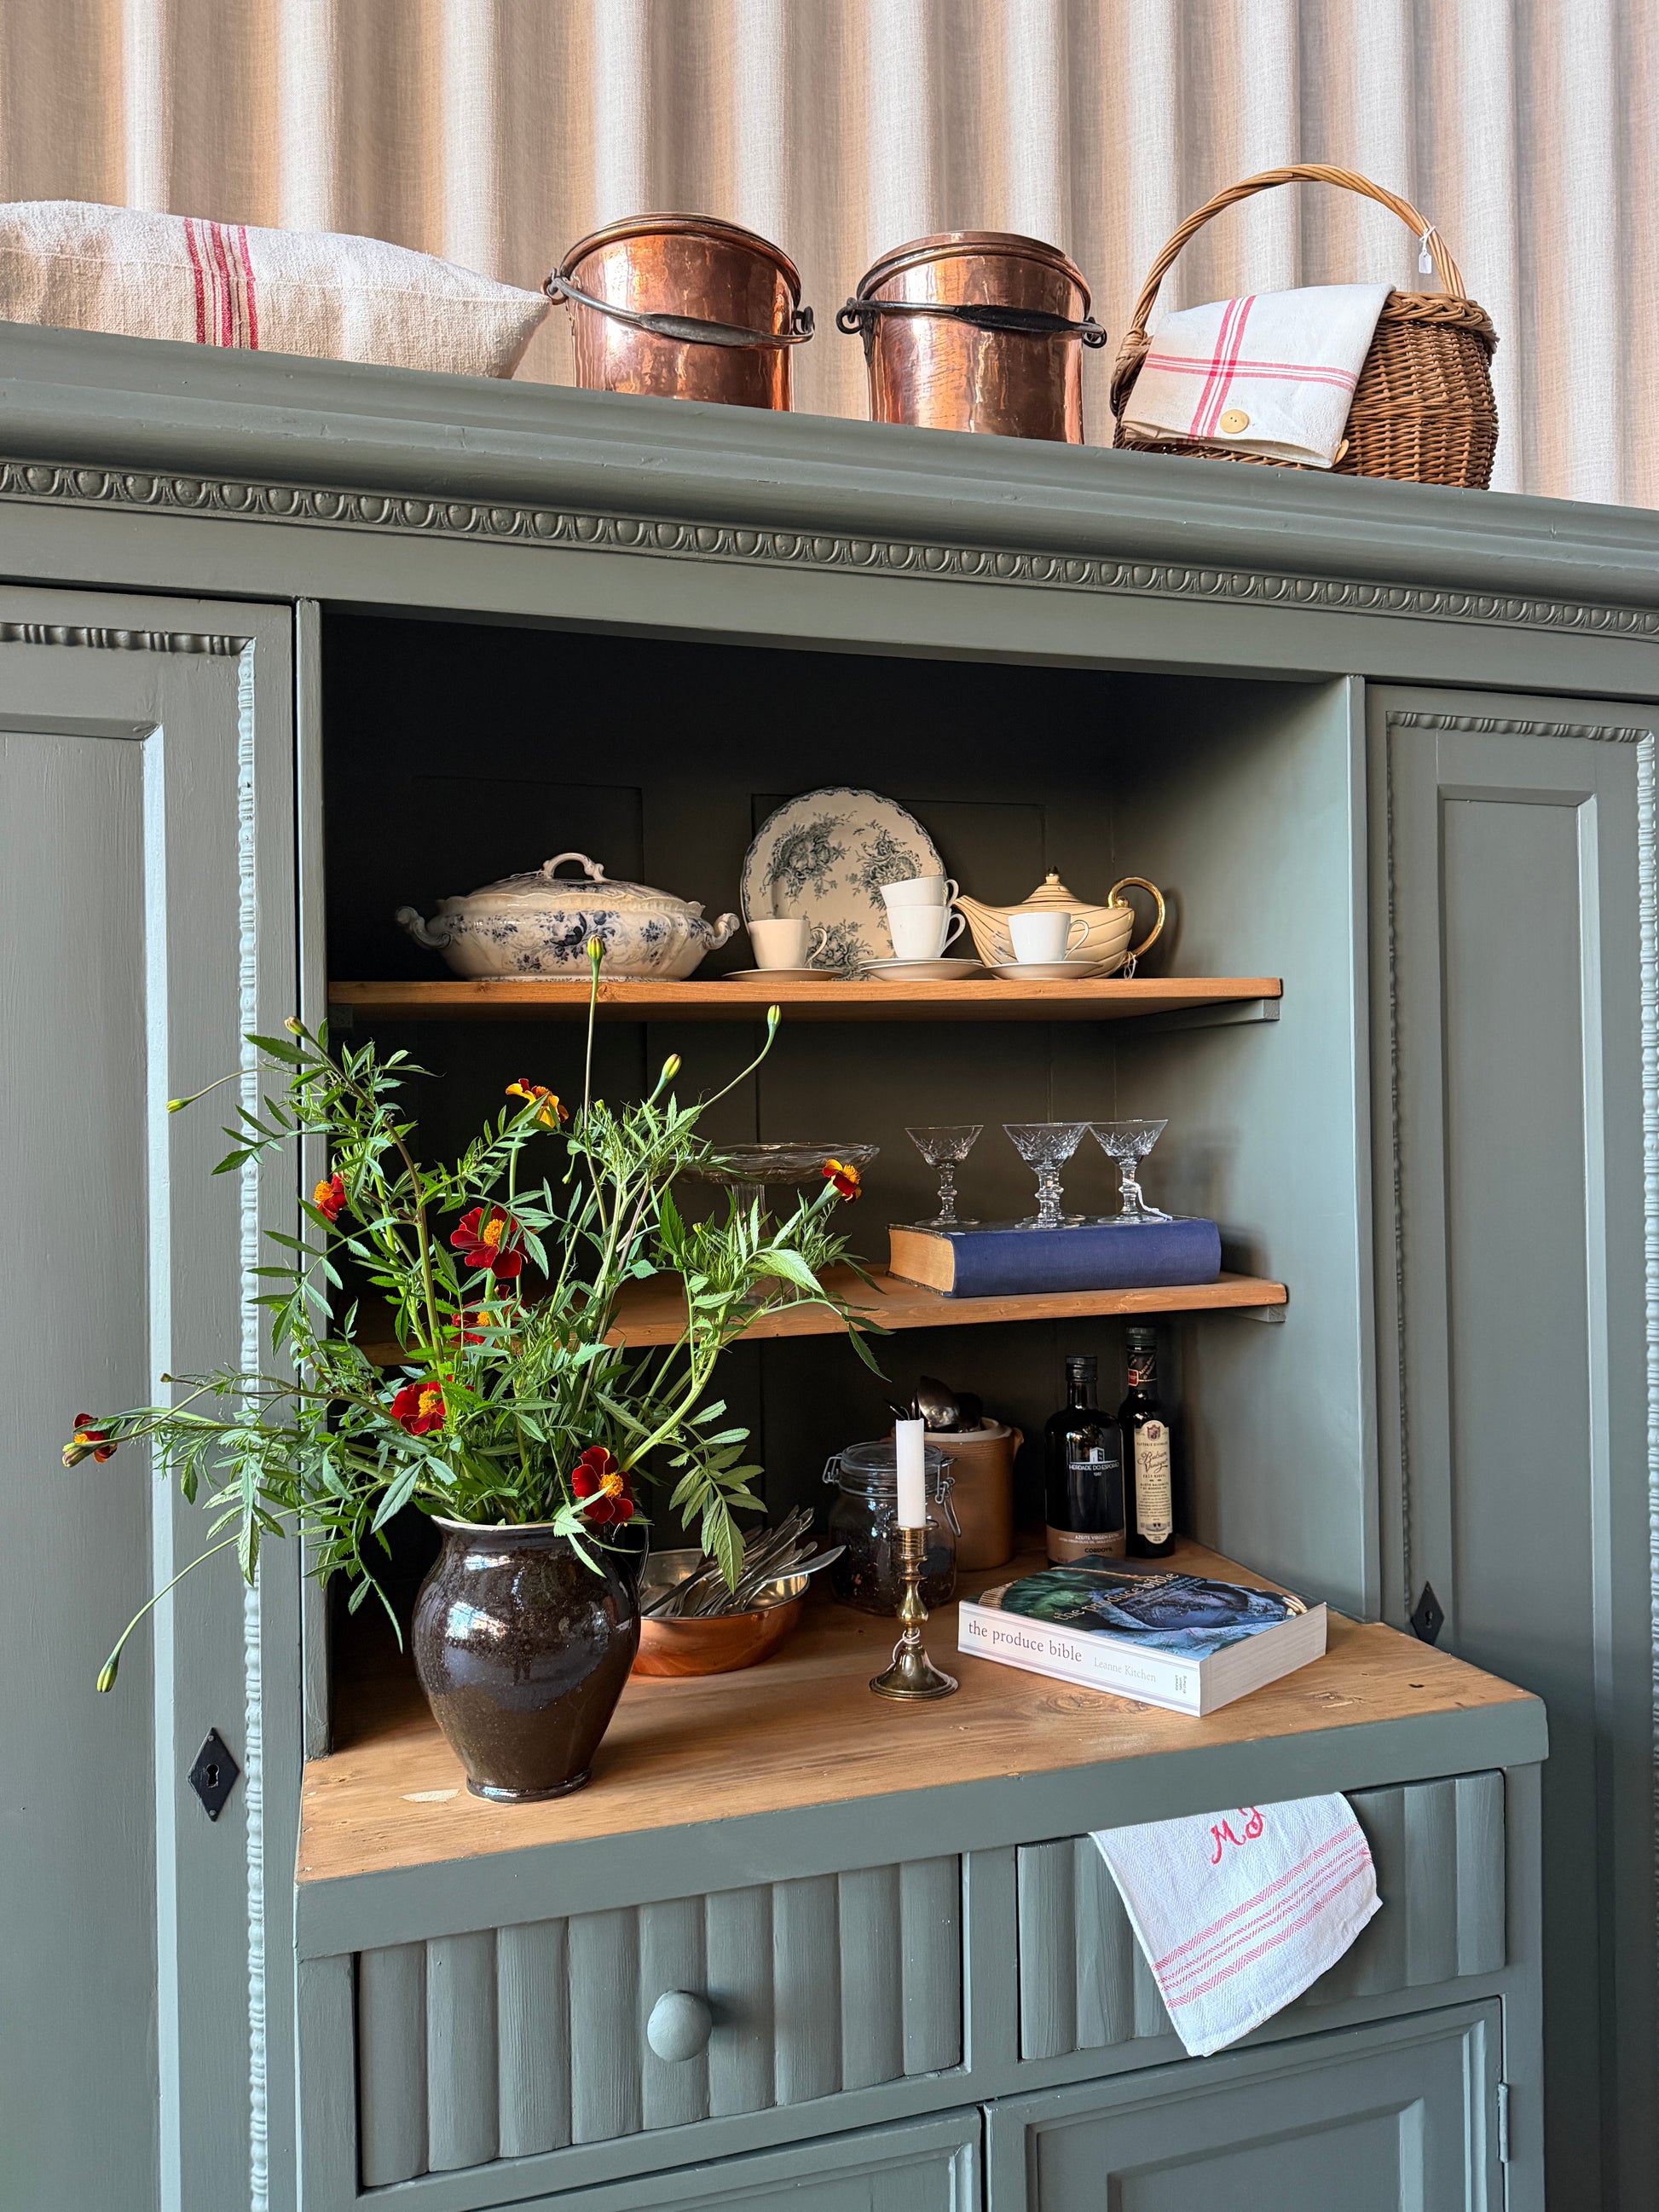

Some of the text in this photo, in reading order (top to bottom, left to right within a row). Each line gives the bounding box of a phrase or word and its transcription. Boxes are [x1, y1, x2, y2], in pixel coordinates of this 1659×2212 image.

[1053, 1608, 1085, 1621] the
[1134, 1573, 1179, 1590] bible
[968, 1620, 1083, 1662] the produce bible
[1094, 1656, 1157, 1683] Leanne Kitchen
